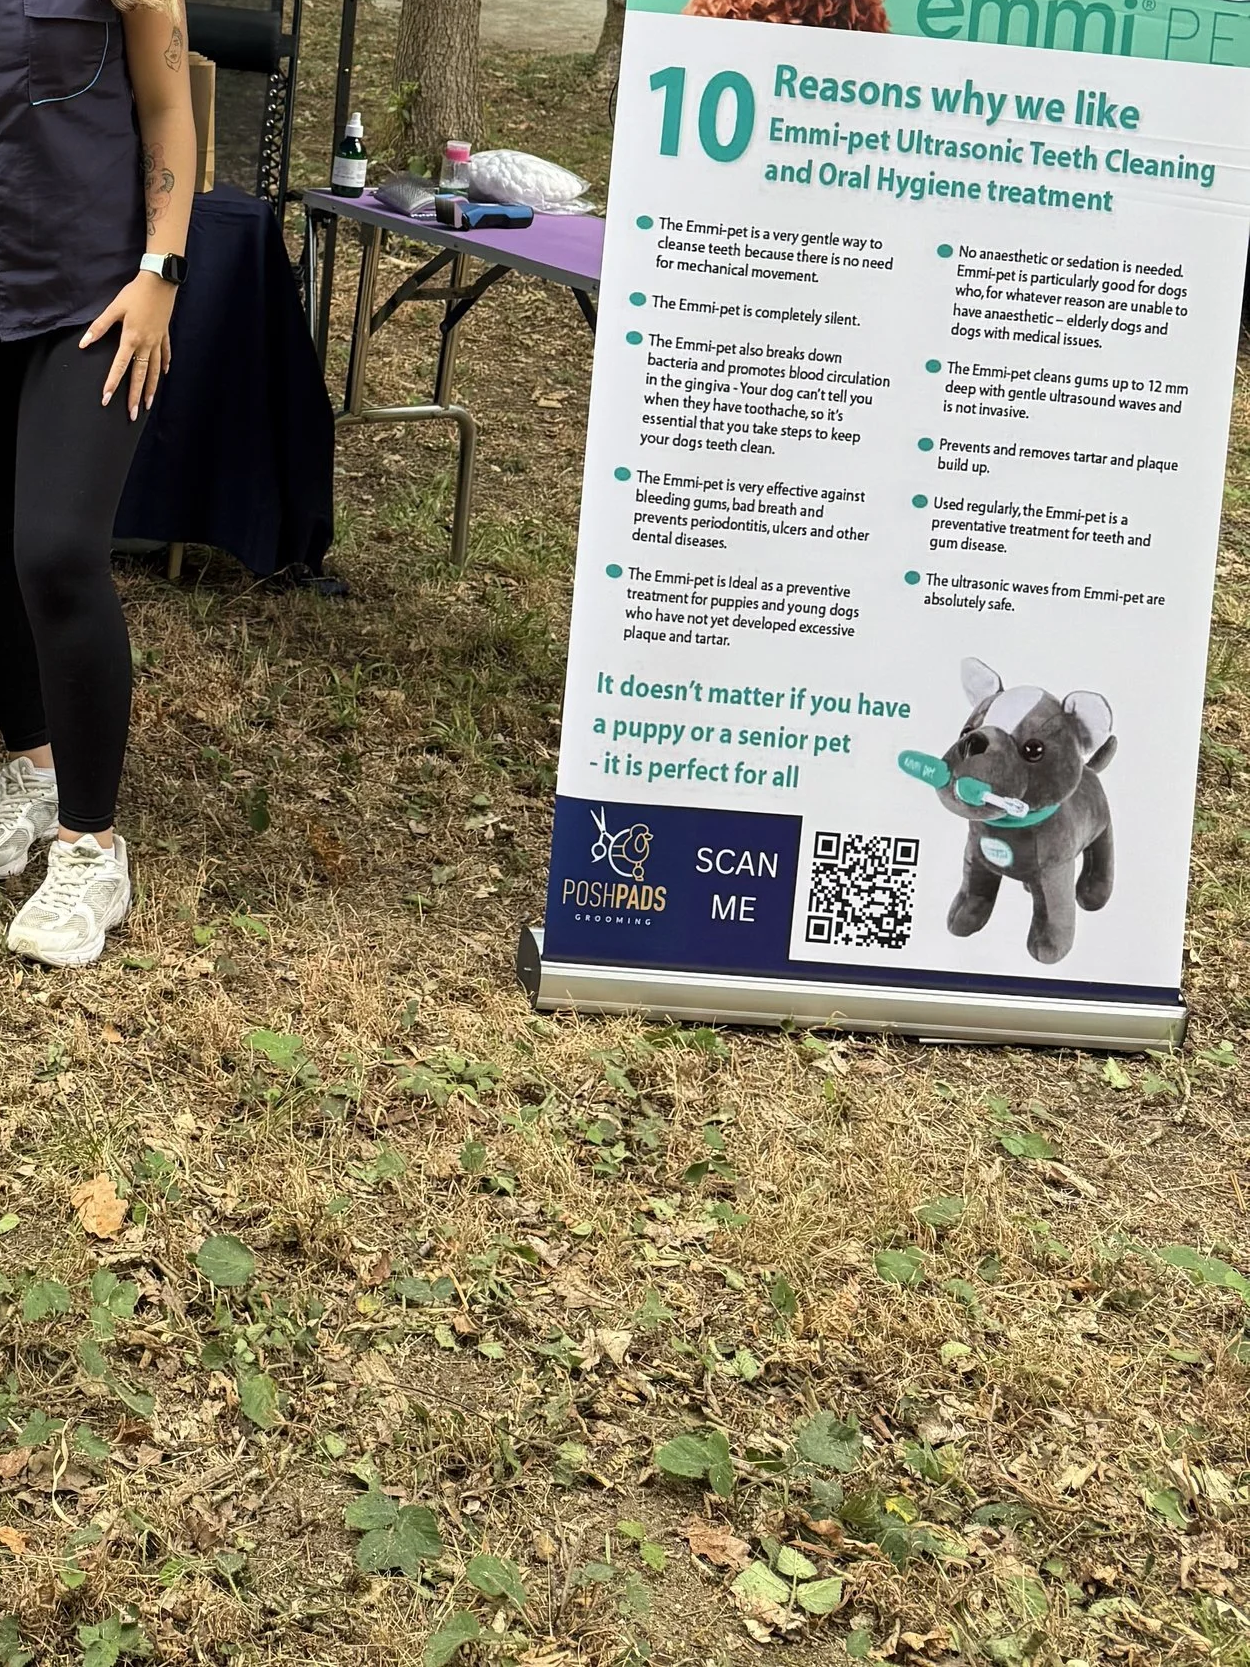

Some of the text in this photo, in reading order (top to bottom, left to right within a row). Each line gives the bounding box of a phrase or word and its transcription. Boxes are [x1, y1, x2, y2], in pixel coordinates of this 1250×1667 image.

[1165, 7, 1249, 66] PE
[774, 64, 1140, 130] Reasons why we like
[650, 67, 755, 163] 10
[769, 116, 1216, 188] Emmi-pet Ultrasonic Teeth Cleaning
[764, 159, 1114, 213] and Oral Hygiene treatment
[658, 216, 883, 252] The Emmi-pet is a very gentle way to
[656, 254, 819, 283] for mechanical movement.
[657, 235, 894, 271] cleanse teeth because there is no need
[652, 294, 861, 327] The Emmi-pet is completely silent.
[937, 455, 990, 477] build up.
[939, 437, 1179, 474] Prevents and removes tartar and plaque
[636, 469, 866, 503] The Emmi-pet is very effective against
[635, 488, 825, 518] bleeding gums, bad breath and
[933, 496, 1129, 526] Used regularly, the Emmi-pet is a
[631, 527, 727, 549] dental diseases.
[633, 512, 870, 542] prevents periodontitis, ulcers and other
[931, 518, 1152, 547] preventative treatment for teeth and
[929, 536, 1007, 554] gum disease.
[923, 591, 1015, 612] absolutely safe.
[925, 572, 1166, 606] The ultrasonic waves from Emmi-pet are
[597, 671, 614, 695] It
[707, 686, 785, 708] matter
[789, 686, 807, 710] if
[809, 695, 851, 717] you
[857, 692, 911, 719] have
[592, 717, 852, 757] a puppy or a senior pet
[604, 751, 621, 775] it
[625, 753, 643, 777] is
[647, 757, 730, 783] perfect
[734, 761, 768, 786] for
[772, 764, 799, 788] all
[696, 848, 777, 877] SCAN
[574, 912, 652, 926] GROOMING
[712, 895, 756, 921] ME
